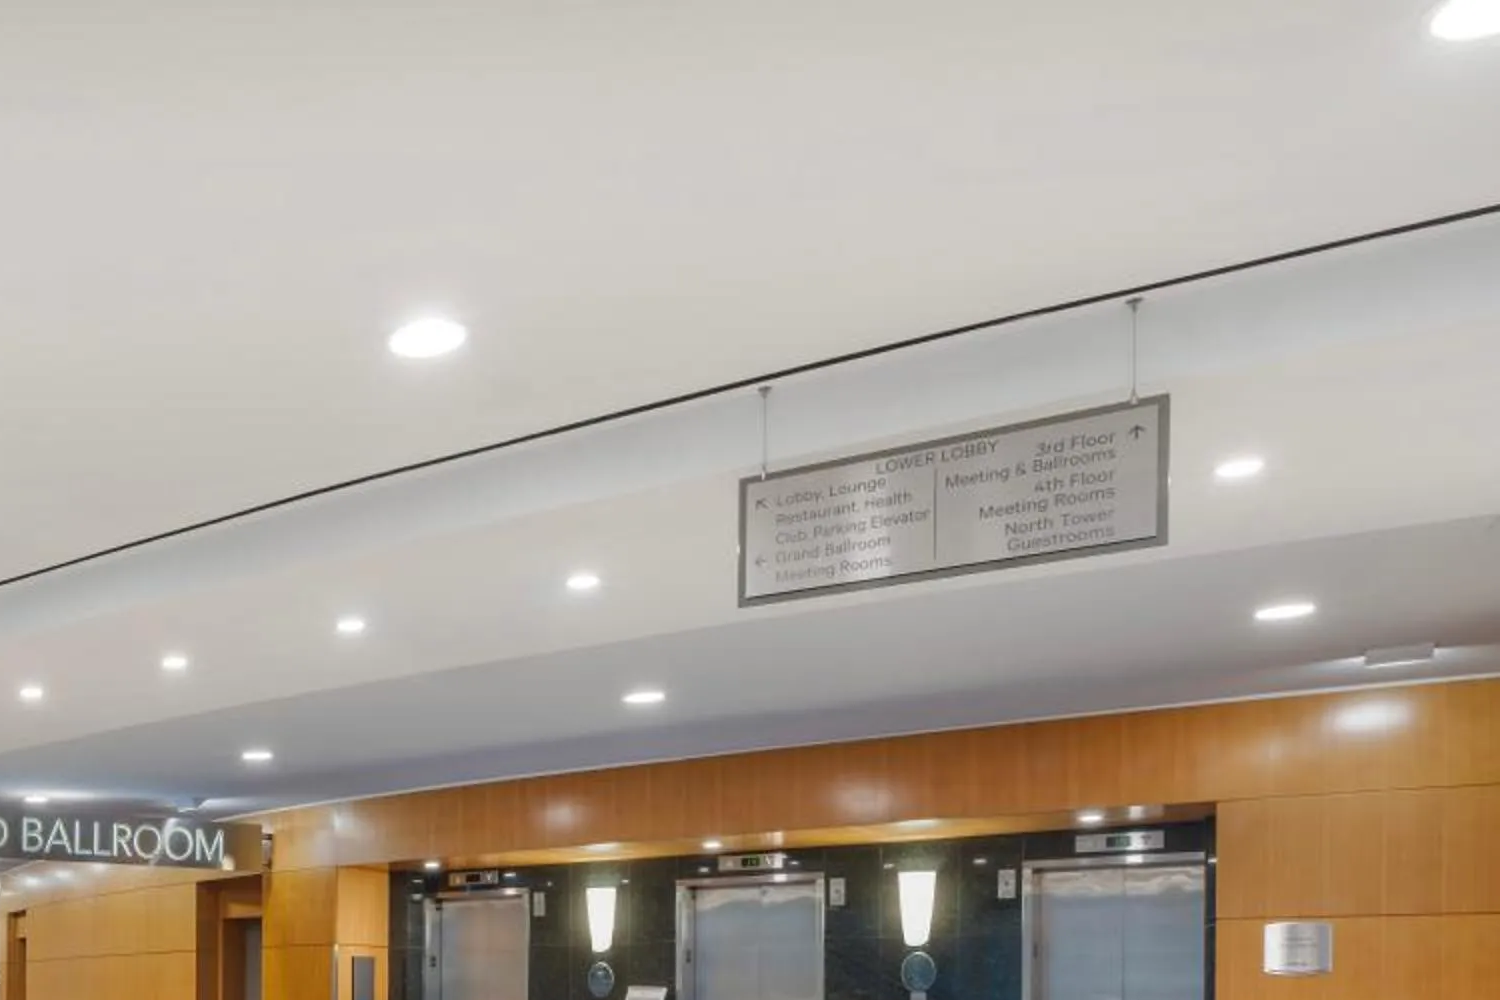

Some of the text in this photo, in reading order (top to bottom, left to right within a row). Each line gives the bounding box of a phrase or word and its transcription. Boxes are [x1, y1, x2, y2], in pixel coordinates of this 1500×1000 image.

[1070, 432, 1116, 451] Floor
[876, 440, 999, 475] LOWER LOBBY
[945, 448, 1117, 489] Meeting & Ballrooms
[829, 477, 886, 497] Lounge
[1034, 470, 1115, 493] 4th Floor
[864, 491, 913, 509] Health
[979, 487, 1117, 520] Meeting Rooms
[870, 508, 932, 530] Elevator
[1004, 509, 1115, 537] North Tower
[775, 536, 891, 564] Grand Ballroom
[1007, 526, 1116, 552] Guestrooms
[776, 556, 894, 582] Meeting Rooms
[21, 816, 226, 865] BALLROOM
